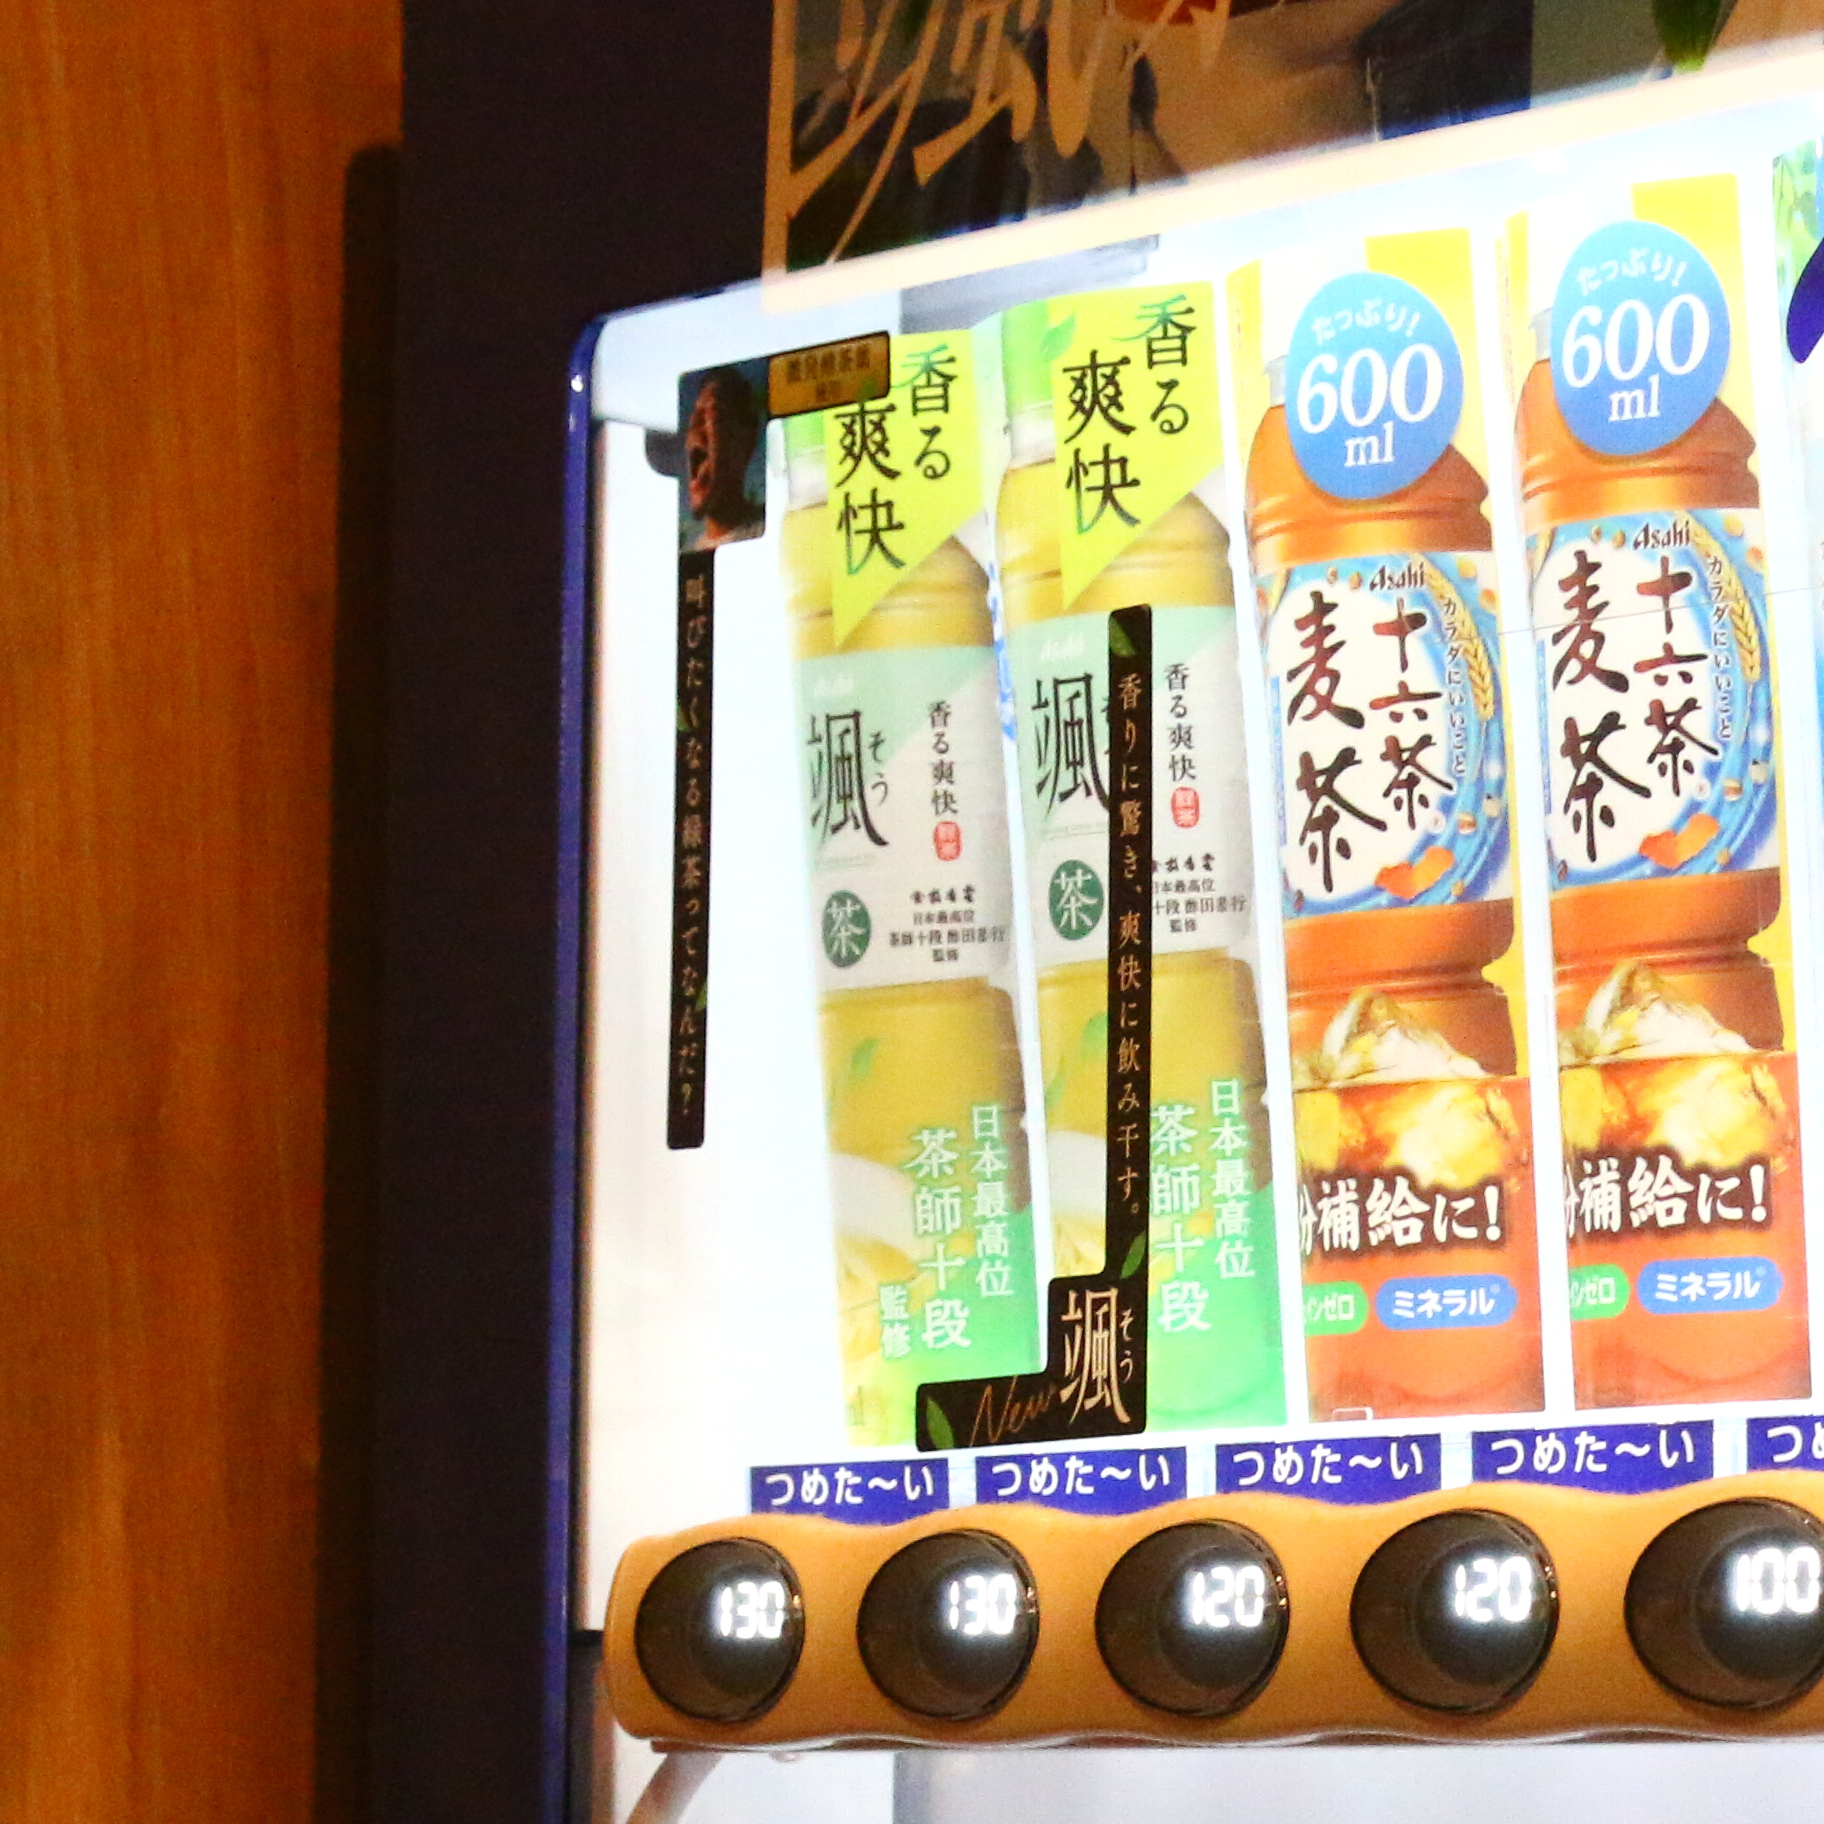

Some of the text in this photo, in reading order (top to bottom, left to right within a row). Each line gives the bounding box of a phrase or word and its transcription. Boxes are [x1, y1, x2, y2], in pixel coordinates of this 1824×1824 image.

[1114, 293, 1197, 436] 香る
[1561, 294, 1710, 389] 600
[897, 343, 958, 481] 香る
[1297, 344, 1444, 434] 600
[1608, 376, 1662, 423] ml
[834, 401, 907, 575] 爽快
[1064, 350, 1141, 537] 爽快
[1344, 423, 1395, 467] ml
[1370, 562, 1425, 591] Asahi
[1633, 520, 1690, 552] Asahi
[1369, 597, 1454, 830] 十六茶
[1551, 549, 1651, 862] 麦茶
[1634, 555, 1719, 797] 十六茶
[869, 730, 888, 806] そう
[928, 701, 959, 815] 香る爽快
[1165, 663, 1196, 782] 香る爽快
[1287, 590, 1387, 893] 麦茶
[827, 900, 864, 960] 茶
[908, 1128, 971, 1350] 茶師十段
[971, 1104, 1014, 1299] 日本最高位
[1119, 1308, 1135, 1384] そう
[1393, 1287, 1495, 1317] ミネラル
[1060, 1288, 1130, 1424] 颯
[717, 1581, 785, 1639] 130
[948, 1573, 1017, 1636] 130
[1190, 1566, 1265, 1628] 120
[1453, 1556, 1532, 1623] 120
[1735, 1546, 1820, 1615] 100
